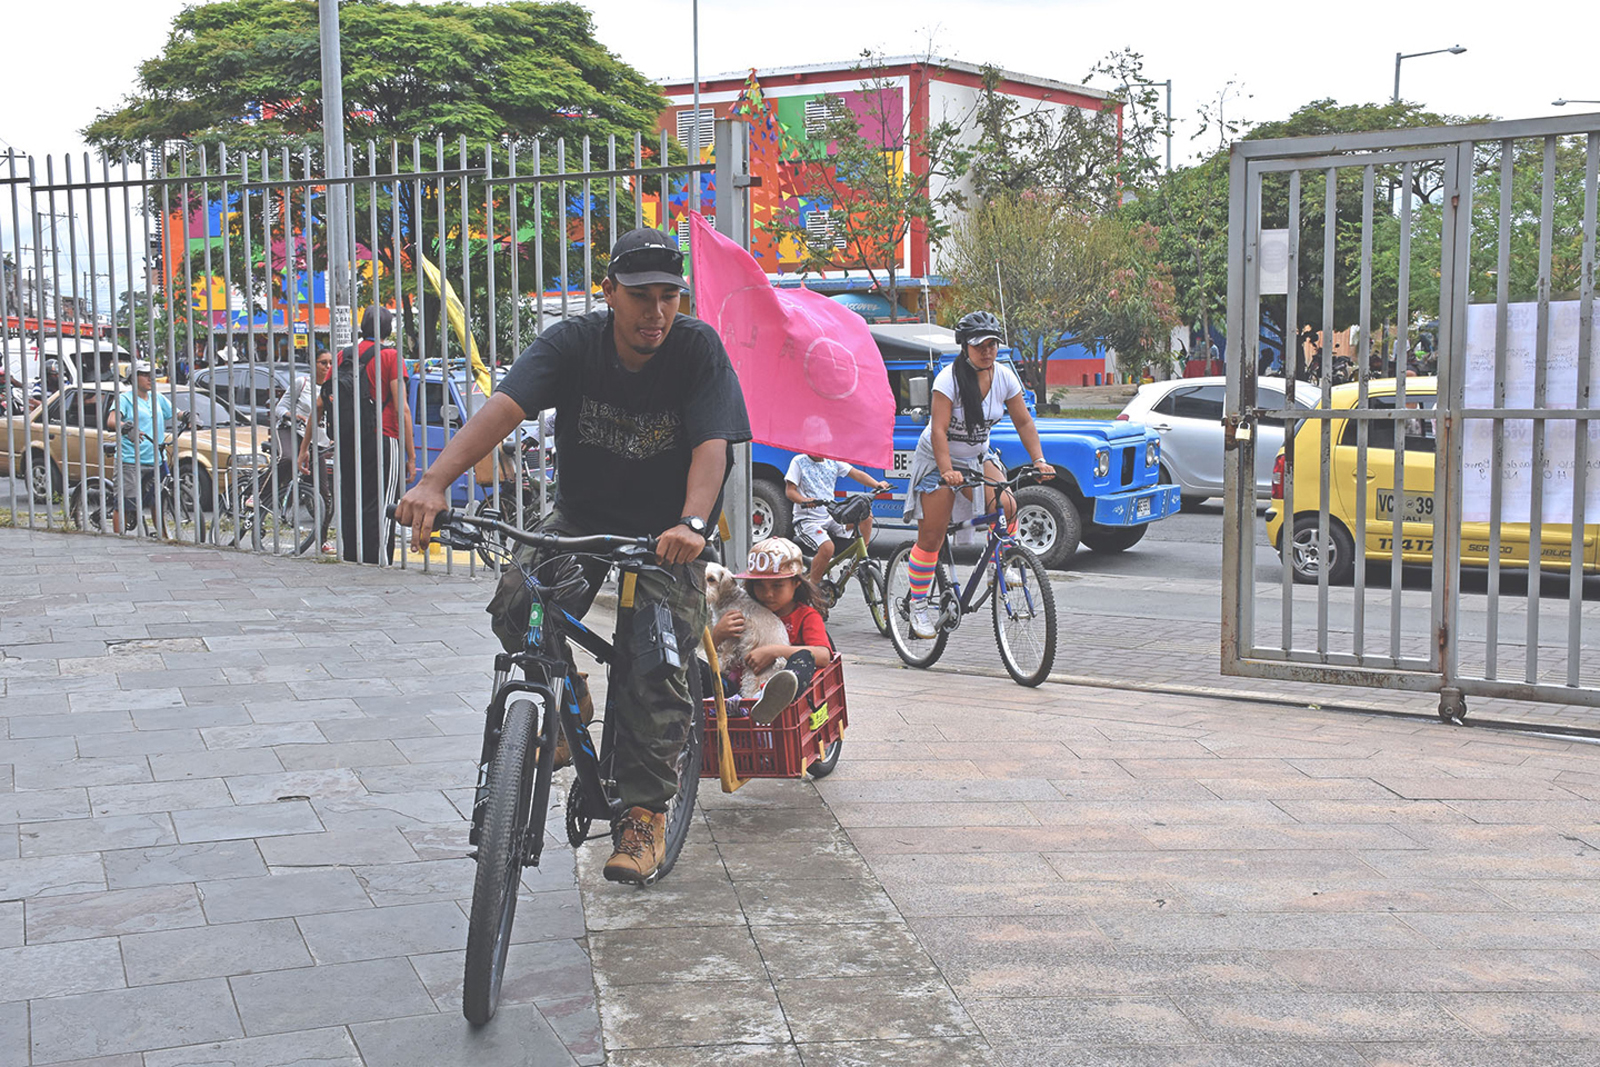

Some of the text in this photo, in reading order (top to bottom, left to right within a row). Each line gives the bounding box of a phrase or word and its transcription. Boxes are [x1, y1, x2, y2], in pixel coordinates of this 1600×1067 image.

[1379, 494, 1434, 515] VC 39
[748, 551, 785, 574] BOY
